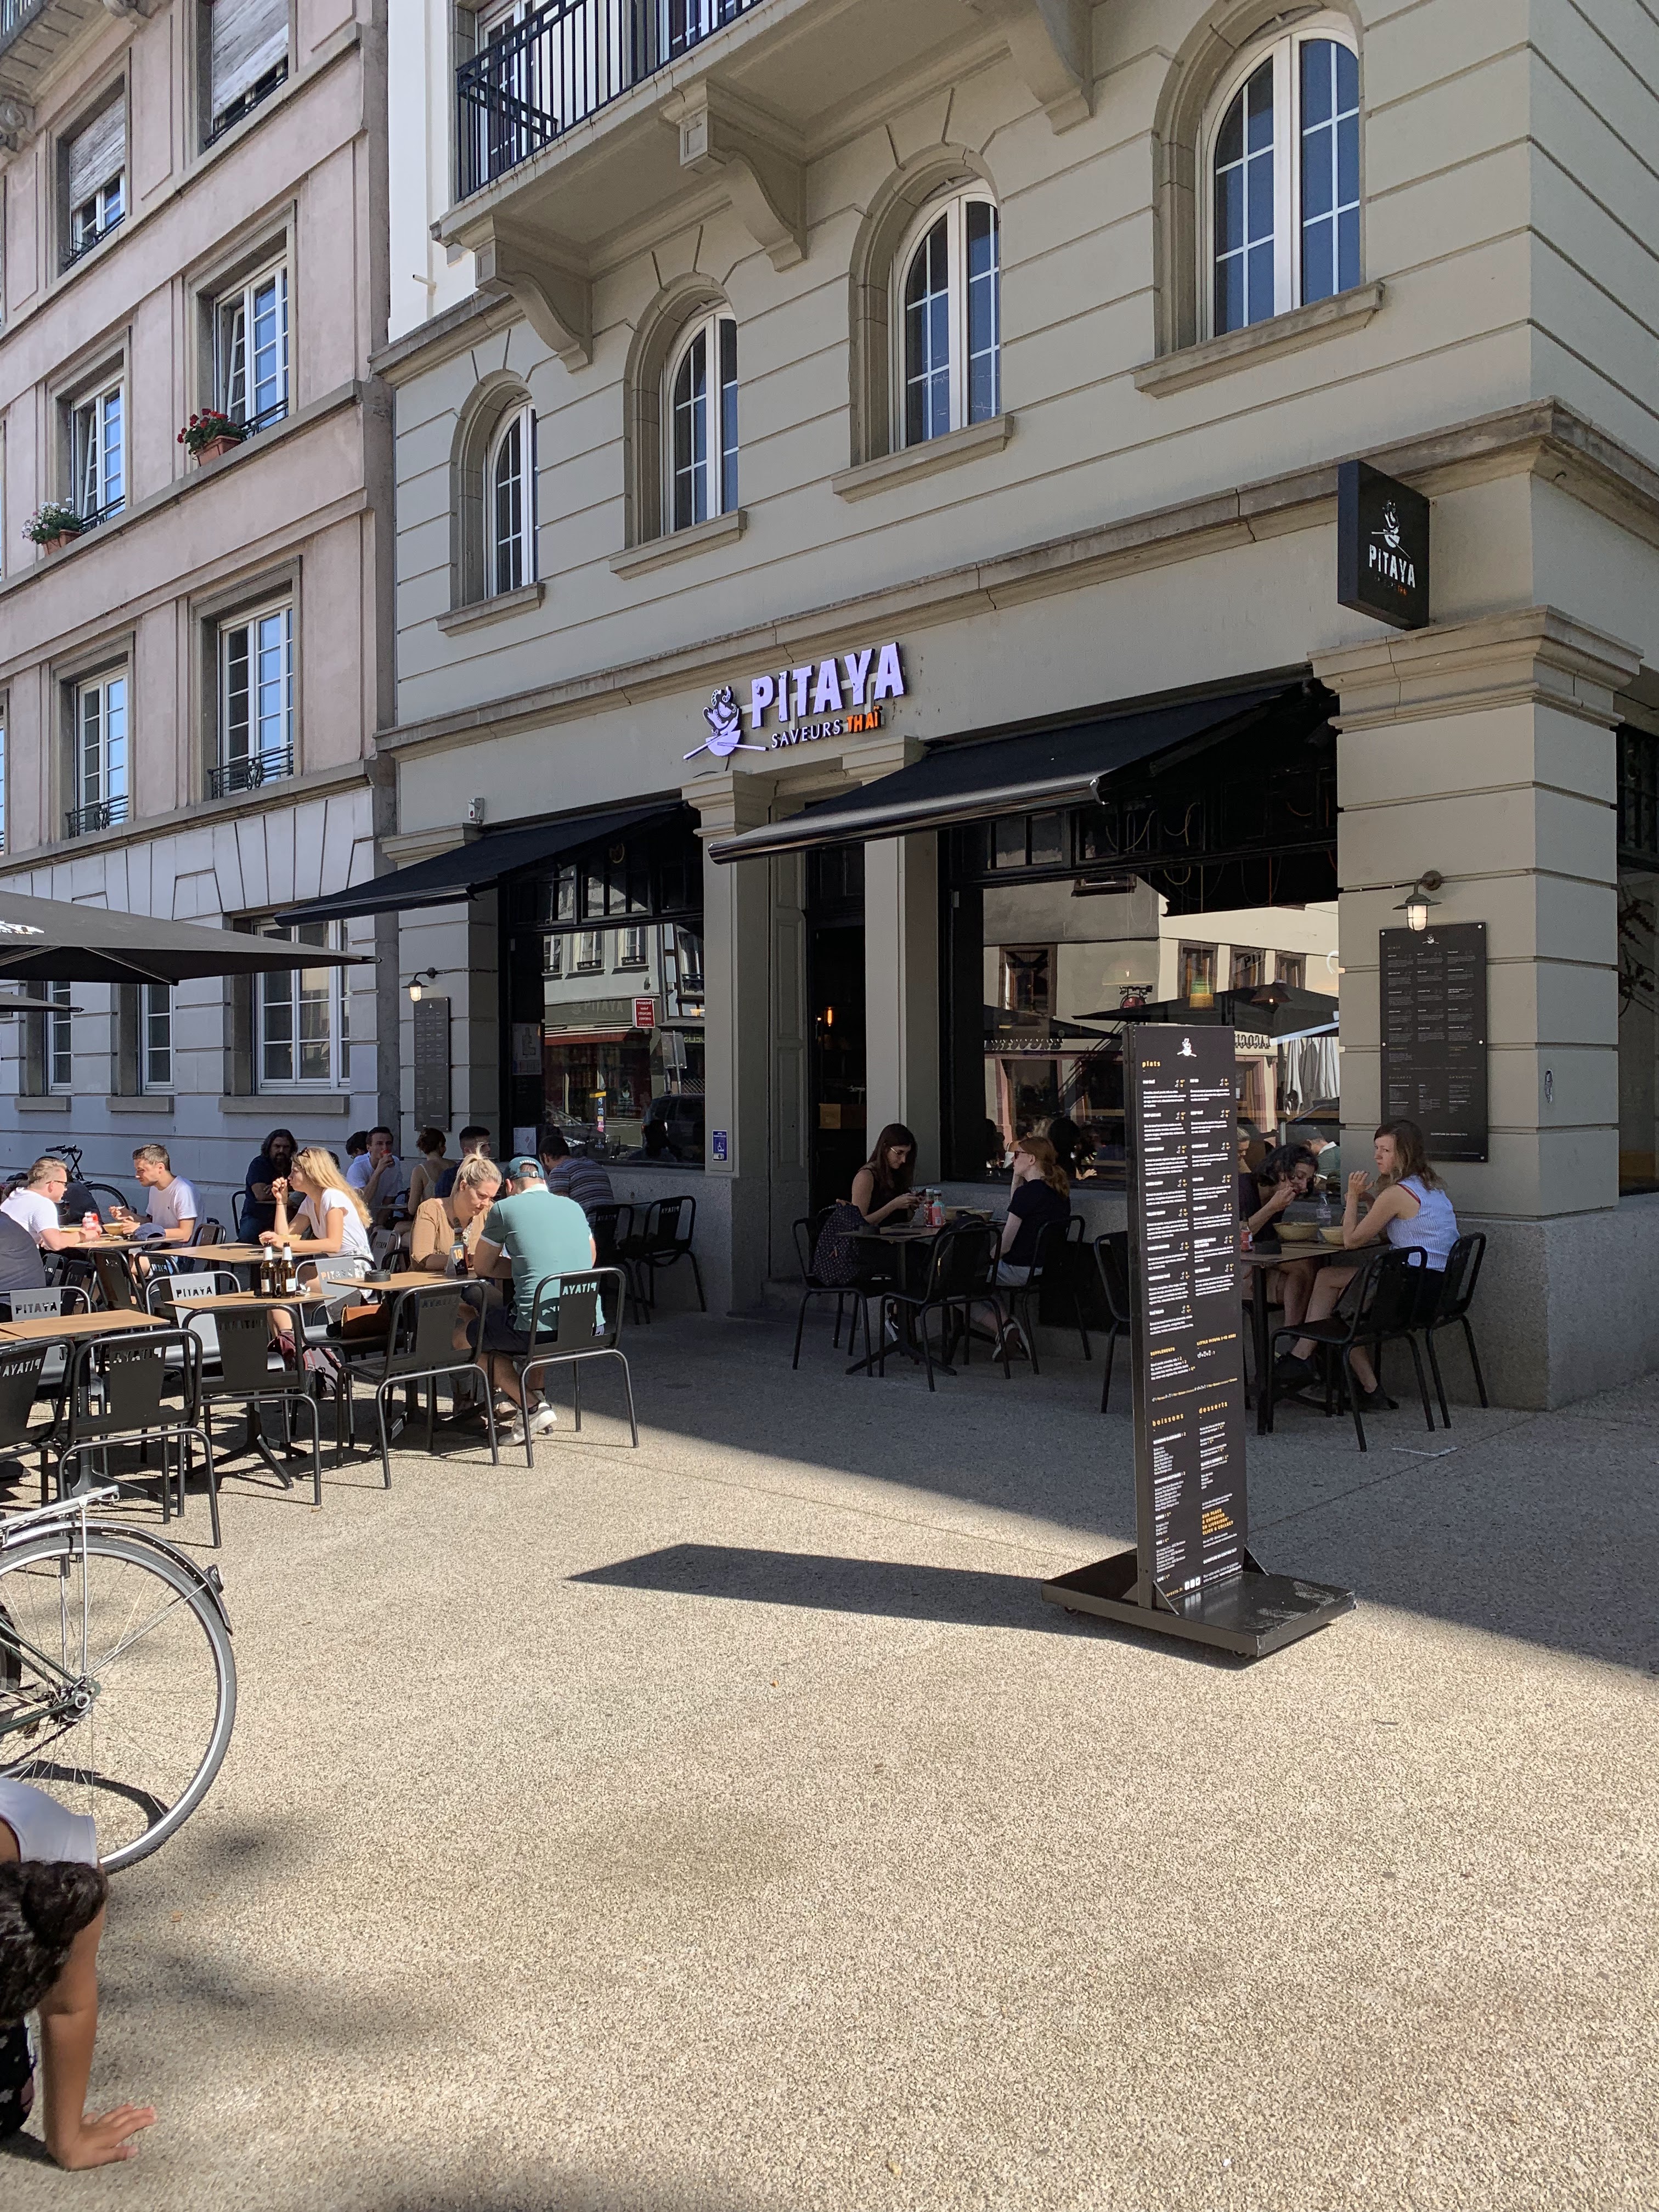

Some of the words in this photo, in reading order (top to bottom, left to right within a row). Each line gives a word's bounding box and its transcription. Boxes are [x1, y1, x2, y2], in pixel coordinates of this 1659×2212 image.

[1368, 544, 1417, 589] PITAYA
[751, 642, 905, 729] PITAYA
[771, 719, 843, 748] SAVEURS
[846, 705, 883, 733] THAÏ
[453, 1248, 463, 1260] 18
[176, 1285, 213, 1298] PITAYA
[15, 1301, 58, 1314] PITAYA
[1198, 1401, 1228, 1414] desserts
[1152, 1413, 1184, 1427] boissons
